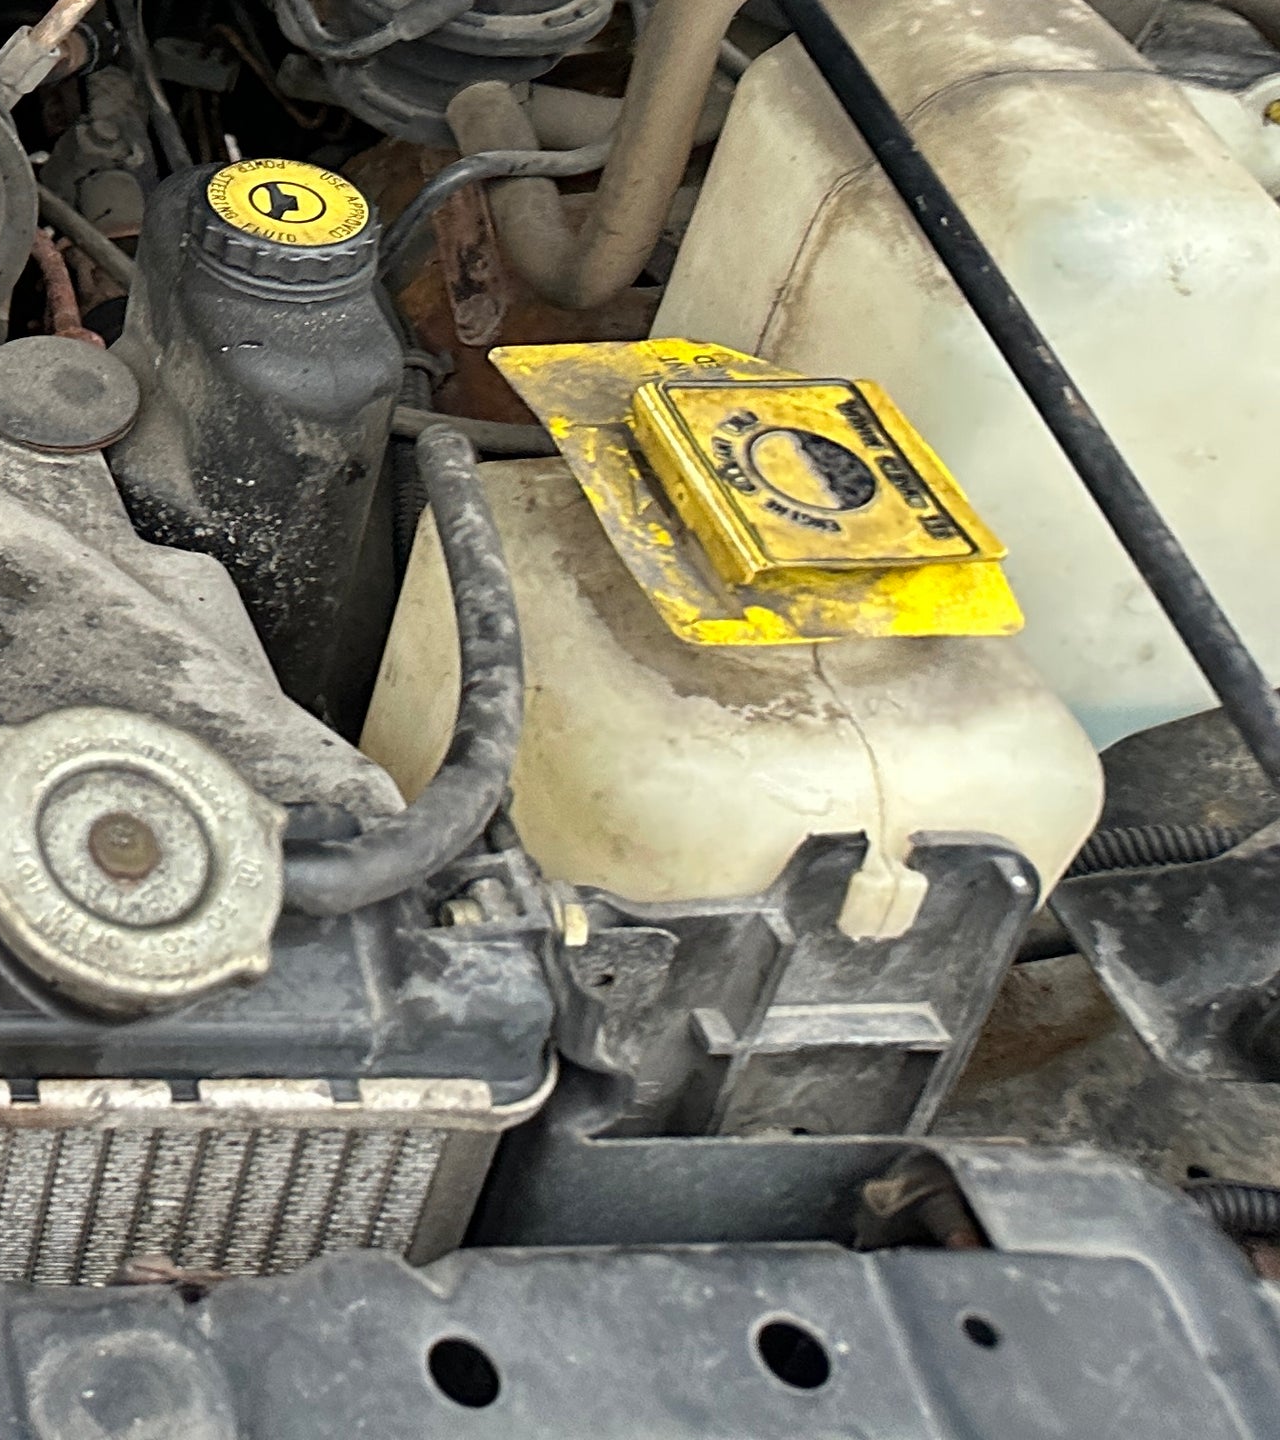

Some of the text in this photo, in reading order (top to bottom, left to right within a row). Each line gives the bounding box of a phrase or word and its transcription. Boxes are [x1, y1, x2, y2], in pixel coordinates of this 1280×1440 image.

[209, 159, 297, 243] POWER STEERING FLUID
[319, 172, 365, 239] USE APPROVED
